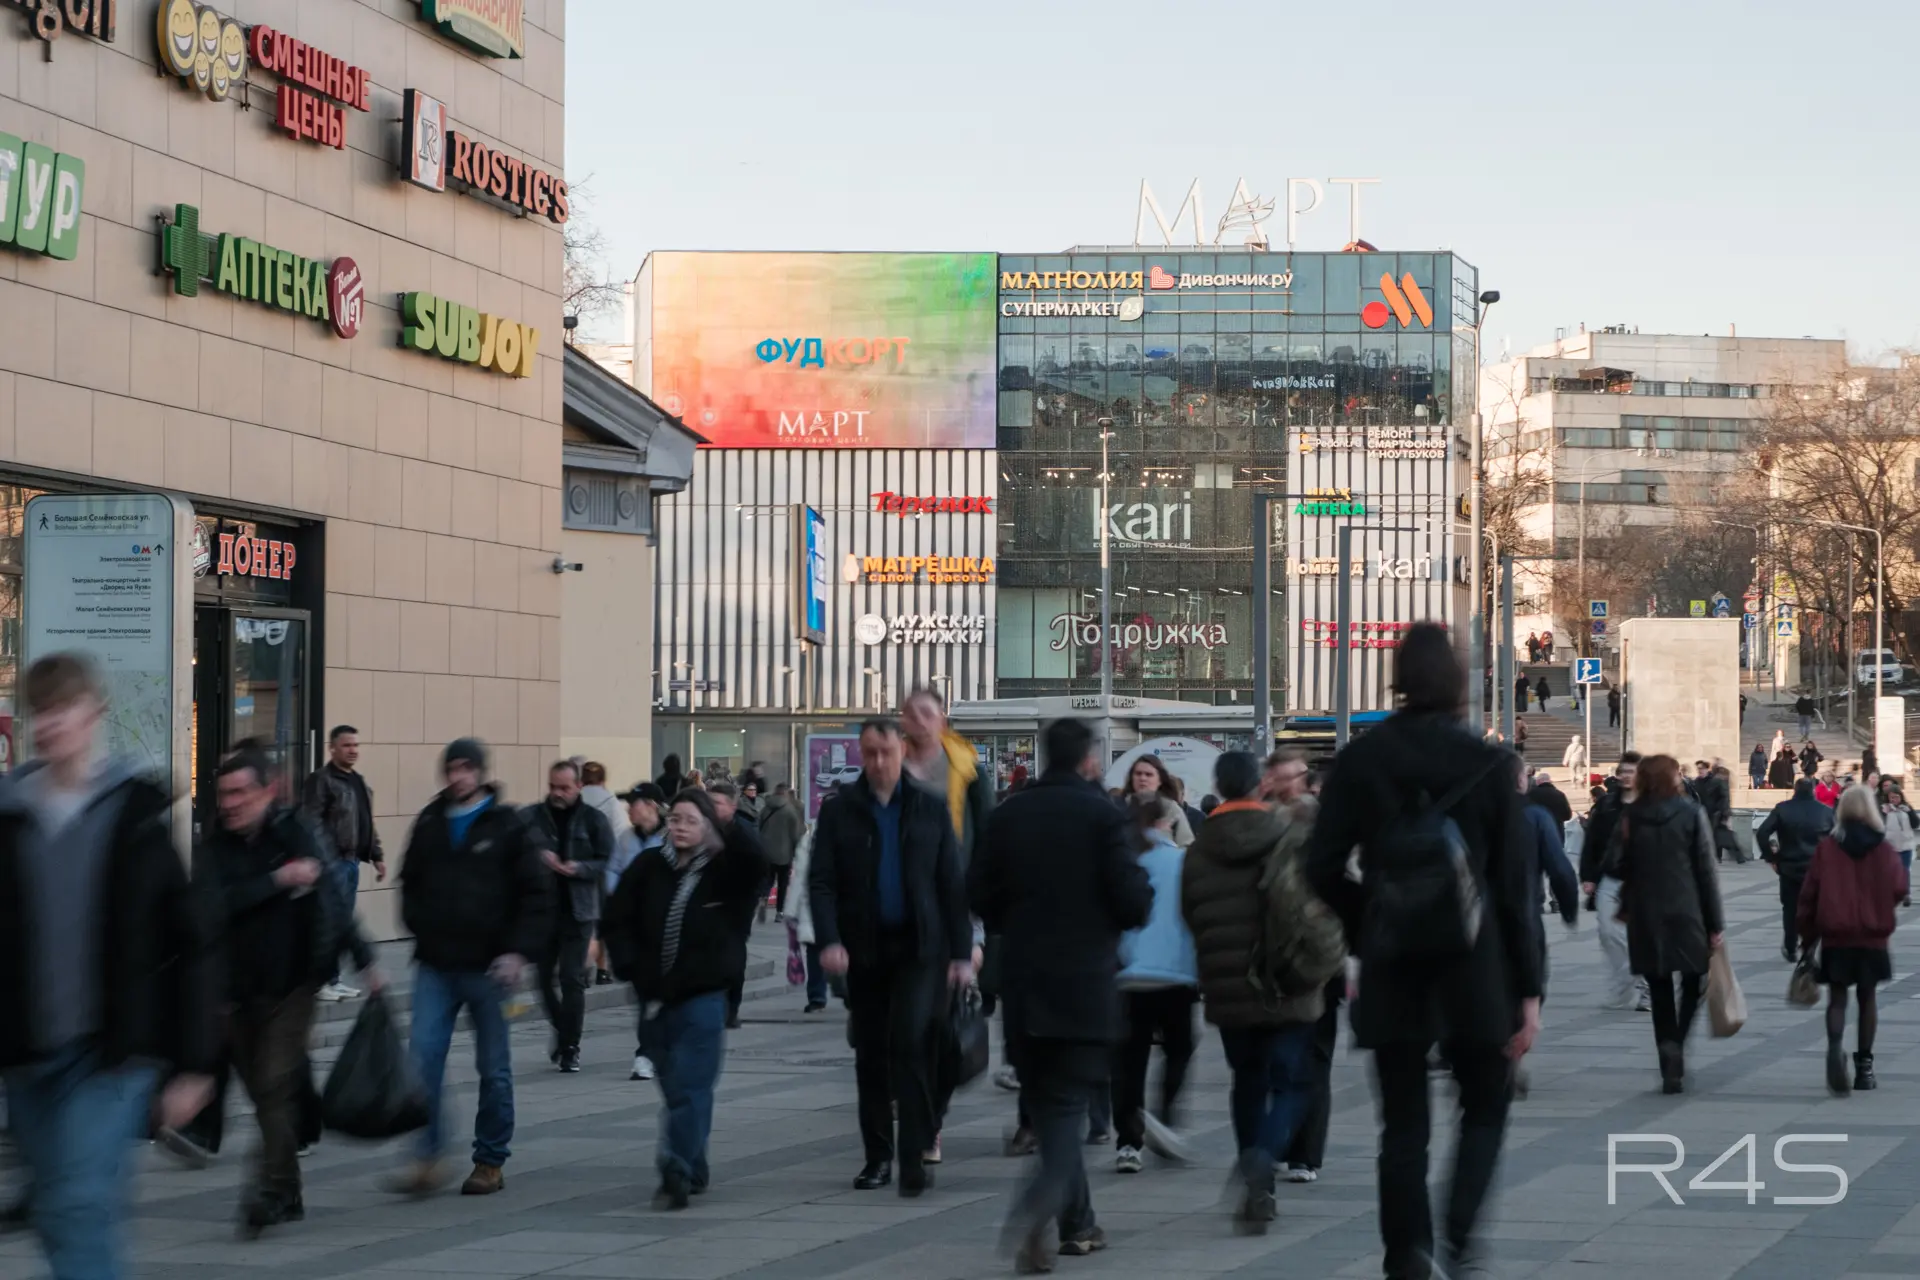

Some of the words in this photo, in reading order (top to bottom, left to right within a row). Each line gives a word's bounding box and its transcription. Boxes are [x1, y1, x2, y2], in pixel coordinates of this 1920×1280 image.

[252, 24, 371, 112] СМЕШНЫЕ
[278, 84, 346, 150] ЦЕНЫ
[448, 130, 569, 224] ROSTIC'S
[1135, 177, 1382, 245] МАРТ
[214, 232, 330, 320] АПТЕКА
[1002, 271, 1144, 289] МАГНОЛИЯ
[1002, 302, 1120, 316] СУПЕРМАРКЕТ
[778, 411, 871, 436] МАРТ
[1367, 430, 1413, 439] РЕМОНТ
[1367, 440, 1447, 449] СМАРТФОНОВ
[1379, 450, 1445, 459] НОУТБУКОВ
[871, 491, 993, 519] Теремок
[1093, 488, 1191, 540] kari
[1294, 503, 1366, 516] АПТЕКА
[55, 514, 87, 522] Большая
[863, 553, 995, 573] МАТРЁШКА
[1378, 550, 1431, 578] kari
[869, 574, 914, 582] салон
[928, 573, 989, 584] красоты
[890, 614, 985, 629] МУЖСКИЕ
[891, 629, 983, 644] СТРИЖКИ
[1050, 613, 1230, 651] Подружка
